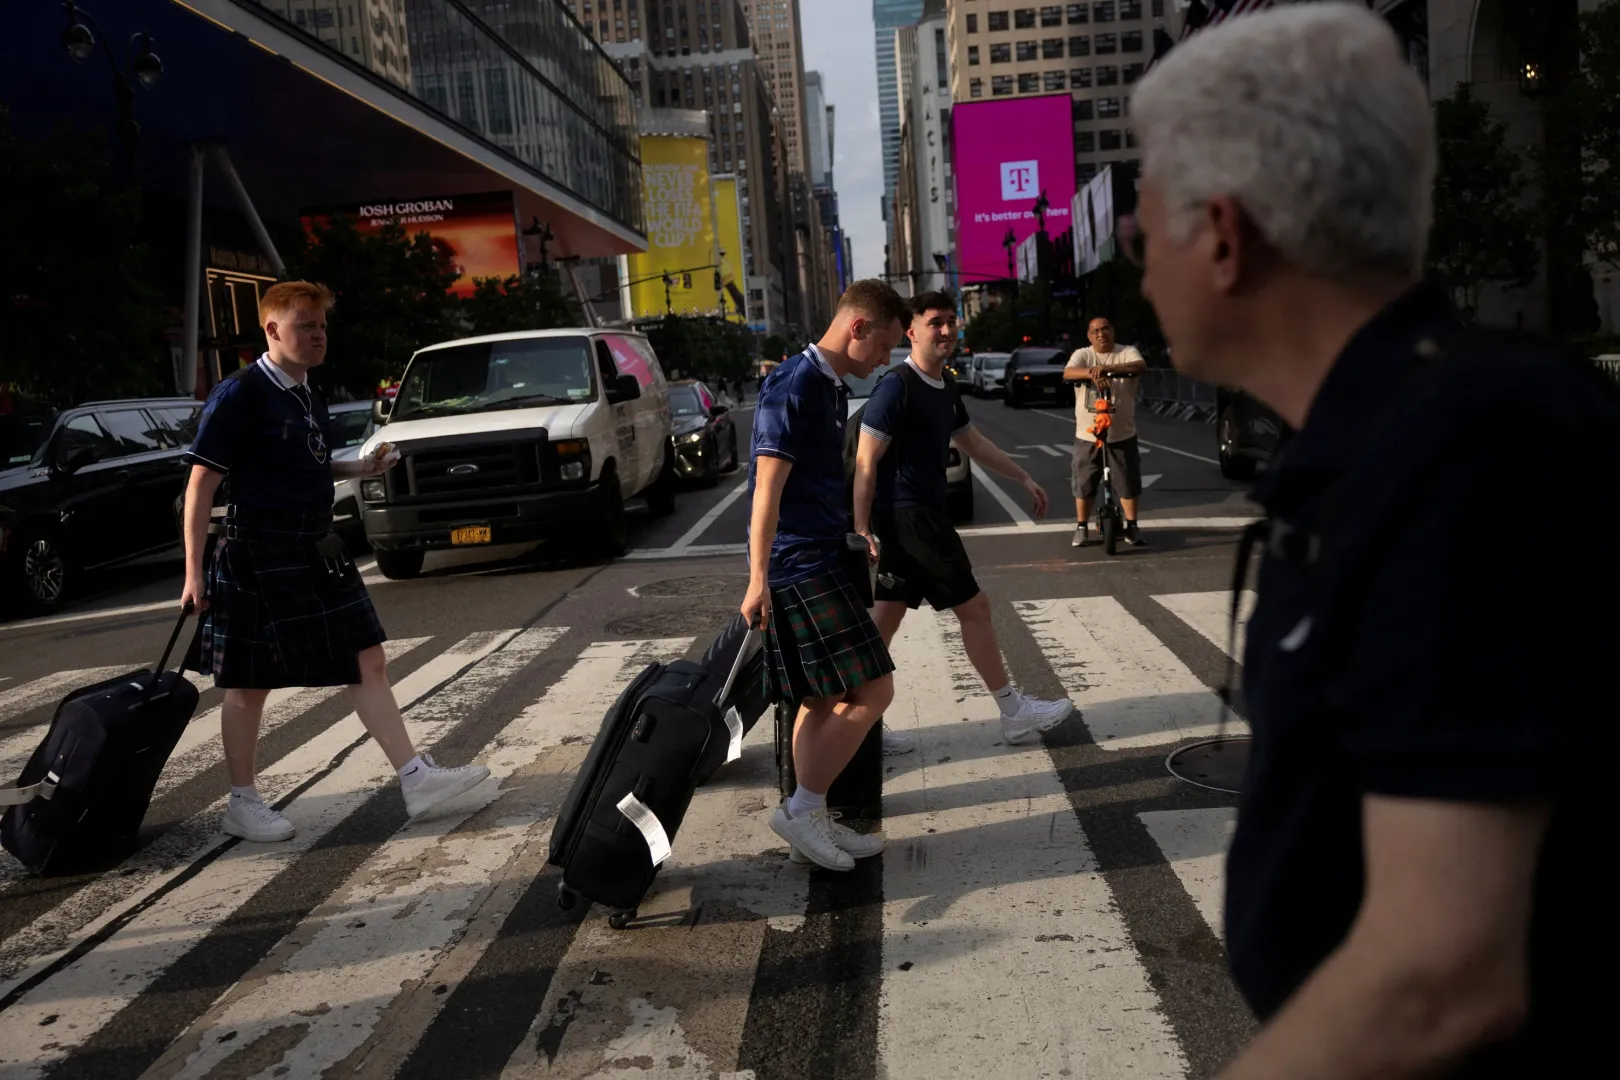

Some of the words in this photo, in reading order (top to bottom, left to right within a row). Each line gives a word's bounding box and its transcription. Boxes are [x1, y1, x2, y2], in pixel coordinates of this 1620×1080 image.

[645, 173, 694, 188] NEVER
[649, 188, 694, 203] LOSES
[395, 199, 453, 214] GROBAN
[645, 203, 671, 219] THE
[675, 203, 703, 218] FIFA
[974, 213, 991, 223] It's
[991, 211, 1022, 222] better
[1023, 210, 1042, 220] ov
[1046, 207, 1069, 217] here
[647, 218, 702, 233] WORLD
